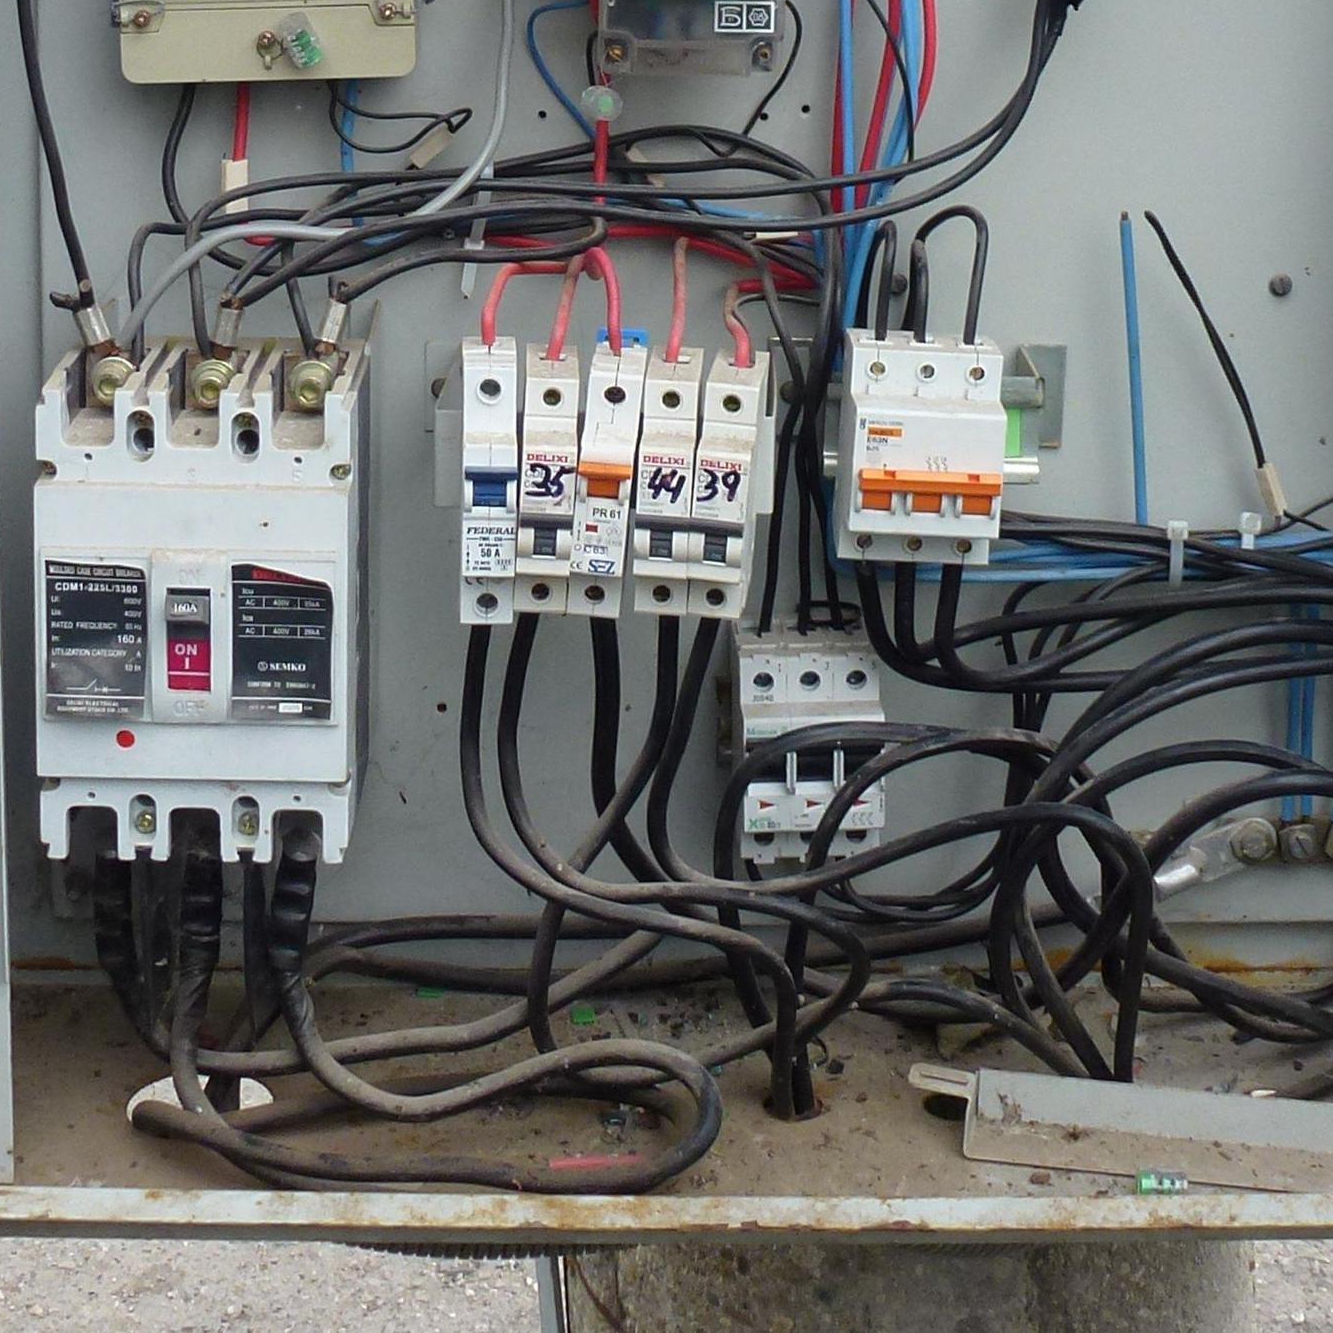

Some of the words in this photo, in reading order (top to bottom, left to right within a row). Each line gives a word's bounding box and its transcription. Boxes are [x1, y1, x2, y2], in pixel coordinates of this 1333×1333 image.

[527, 453, 569, 464] DELIXI
[643, 455, 685, 466] DELIXI
[700, 459, 742, 471] DELIXI
[647, 467, 687, 504] 44
[696, 468, 742, 503] 39
[593, 508, 608, 518] PR
[466, 526, 516, 535] FEDERAL
[480, 547, 492, 558] 50
[494, 548, 501, 558] A
[117, 634, 135, 644] 160
[174, 643, 198, 656] ON
[269, 662, 307, 672] SEMKO
